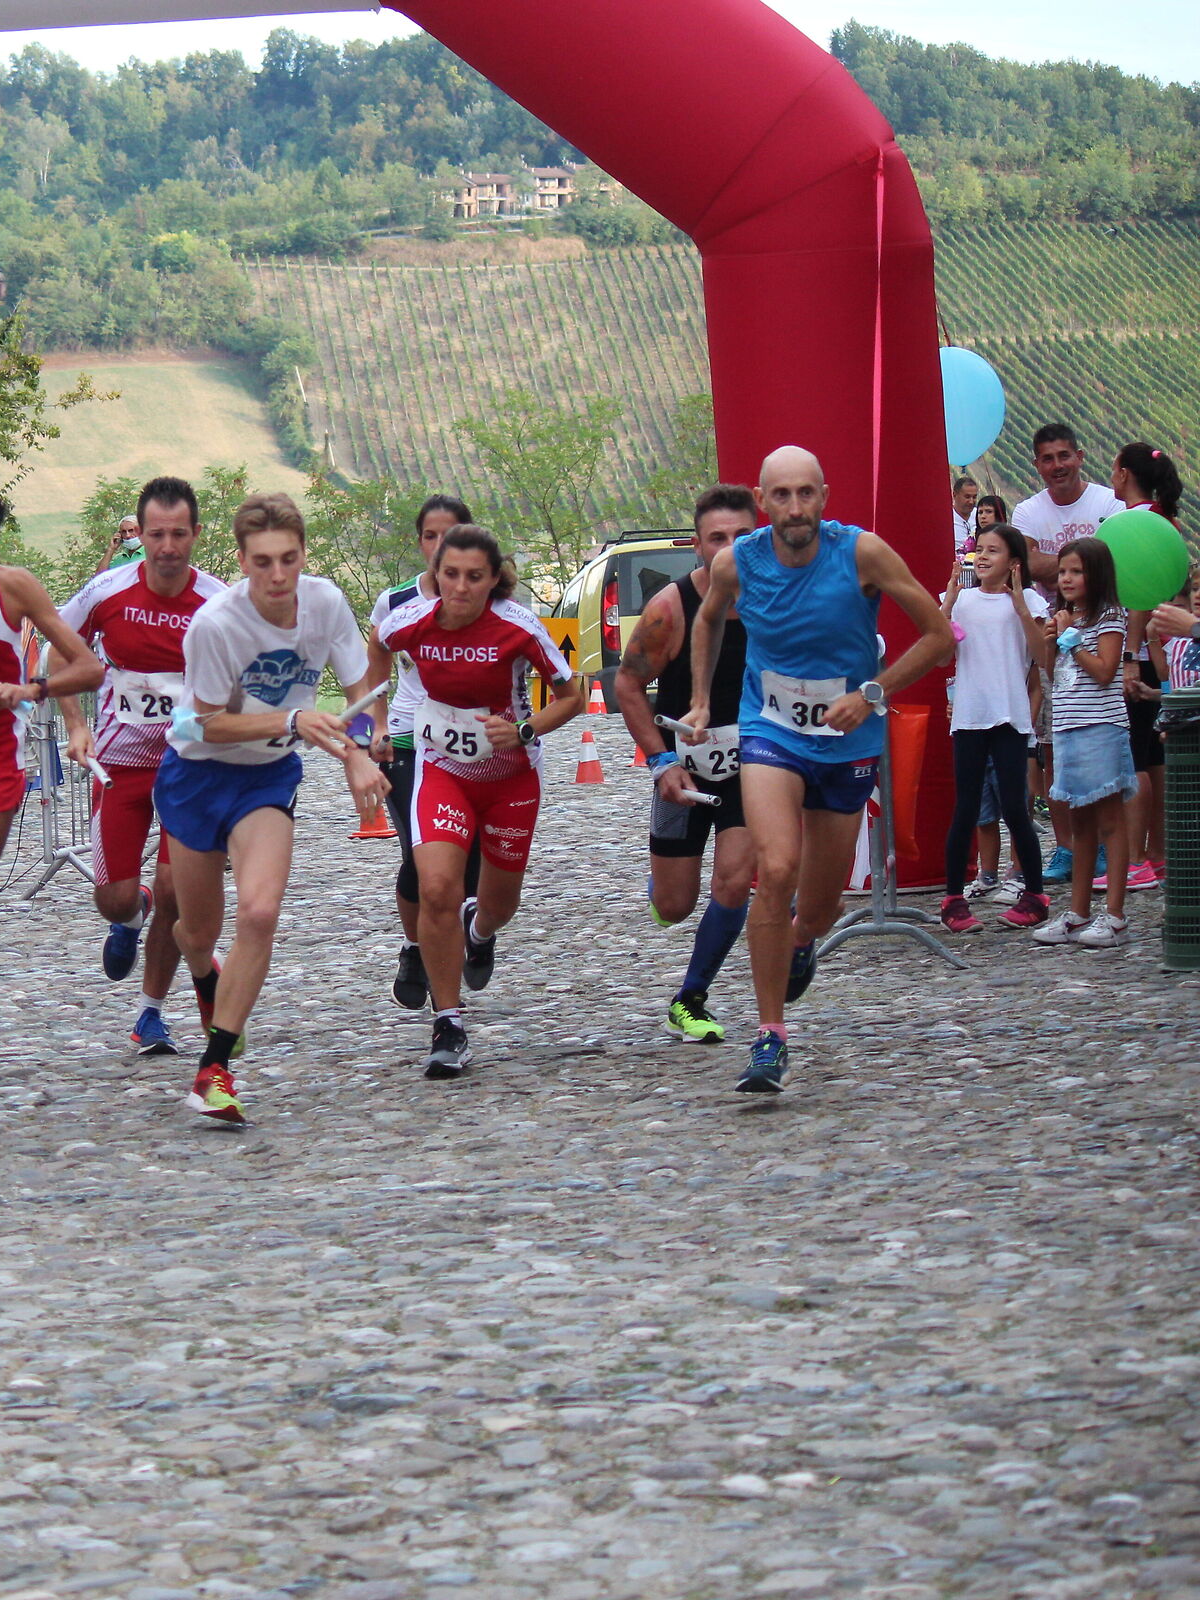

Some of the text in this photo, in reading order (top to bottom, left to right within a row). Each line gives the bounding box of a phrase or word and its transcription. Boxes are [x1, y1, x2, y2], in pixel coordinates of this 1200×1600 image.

[124, 606, 192, 631] ITALPOS
[420, 644, 499, 663] ITALPOSE
[119, 693, 174, 718] A 28
[768, 694, 829, 728] A 30
[422, 724, 478, 757] A 25
[684, 747, 740, 776] A 23
